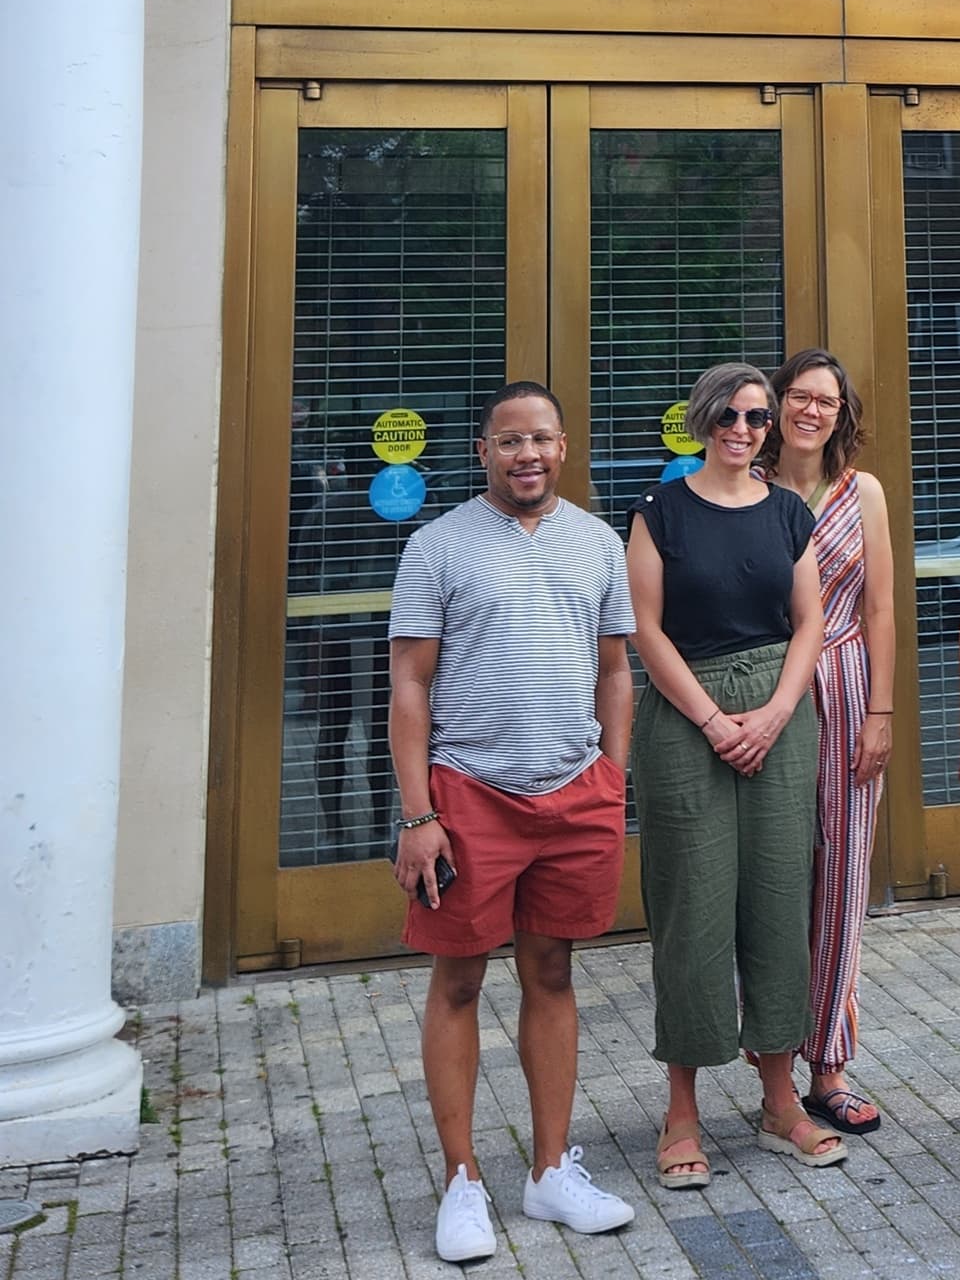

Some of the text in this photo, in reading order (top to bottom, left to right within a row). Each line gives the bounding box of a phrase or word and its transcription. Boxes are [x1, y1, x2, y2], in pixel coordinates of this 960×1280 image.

[375, 419, 423, 429] AUTOMATIC
[374, 430, 425, 442] CAUTION
[388, 444, 411, 452] DOOR
